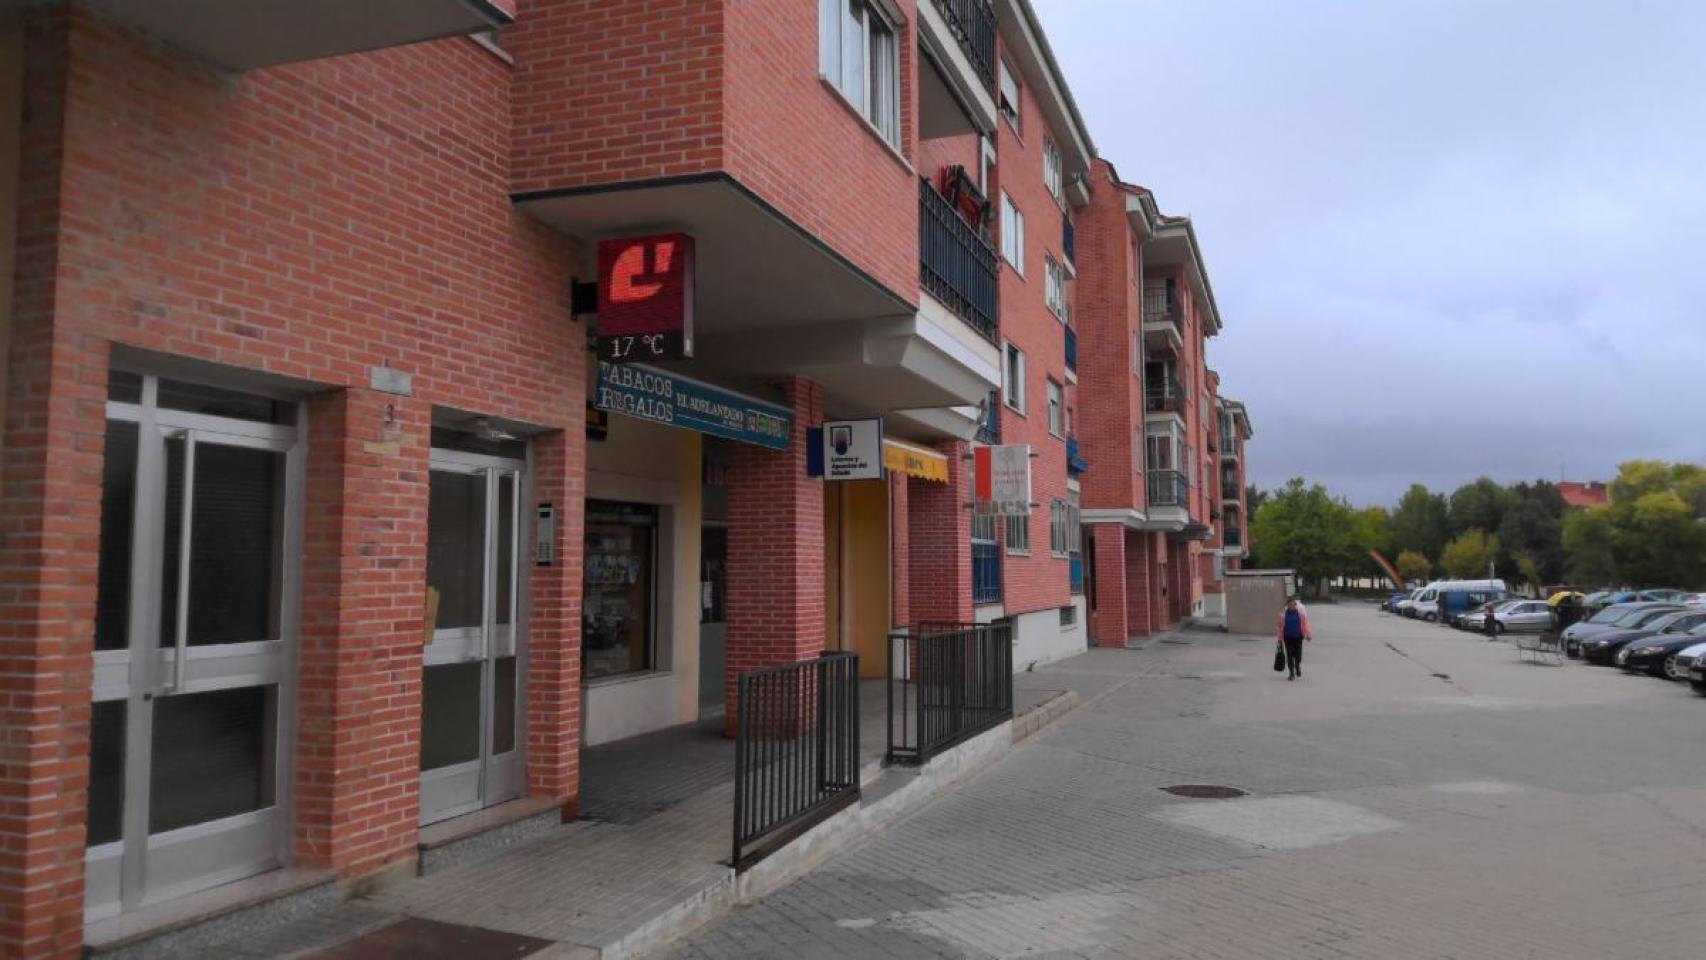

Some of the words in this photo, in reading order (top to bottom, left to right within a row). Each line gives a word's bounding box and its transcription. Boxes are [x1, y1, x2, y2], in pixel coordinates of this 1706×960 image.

[611, 336, 635, 357] 17
[601, 362, 672, 398] TABACOS
[384, 404, 395, 424] 3
[597, 388, 673, 421] REGALOS
